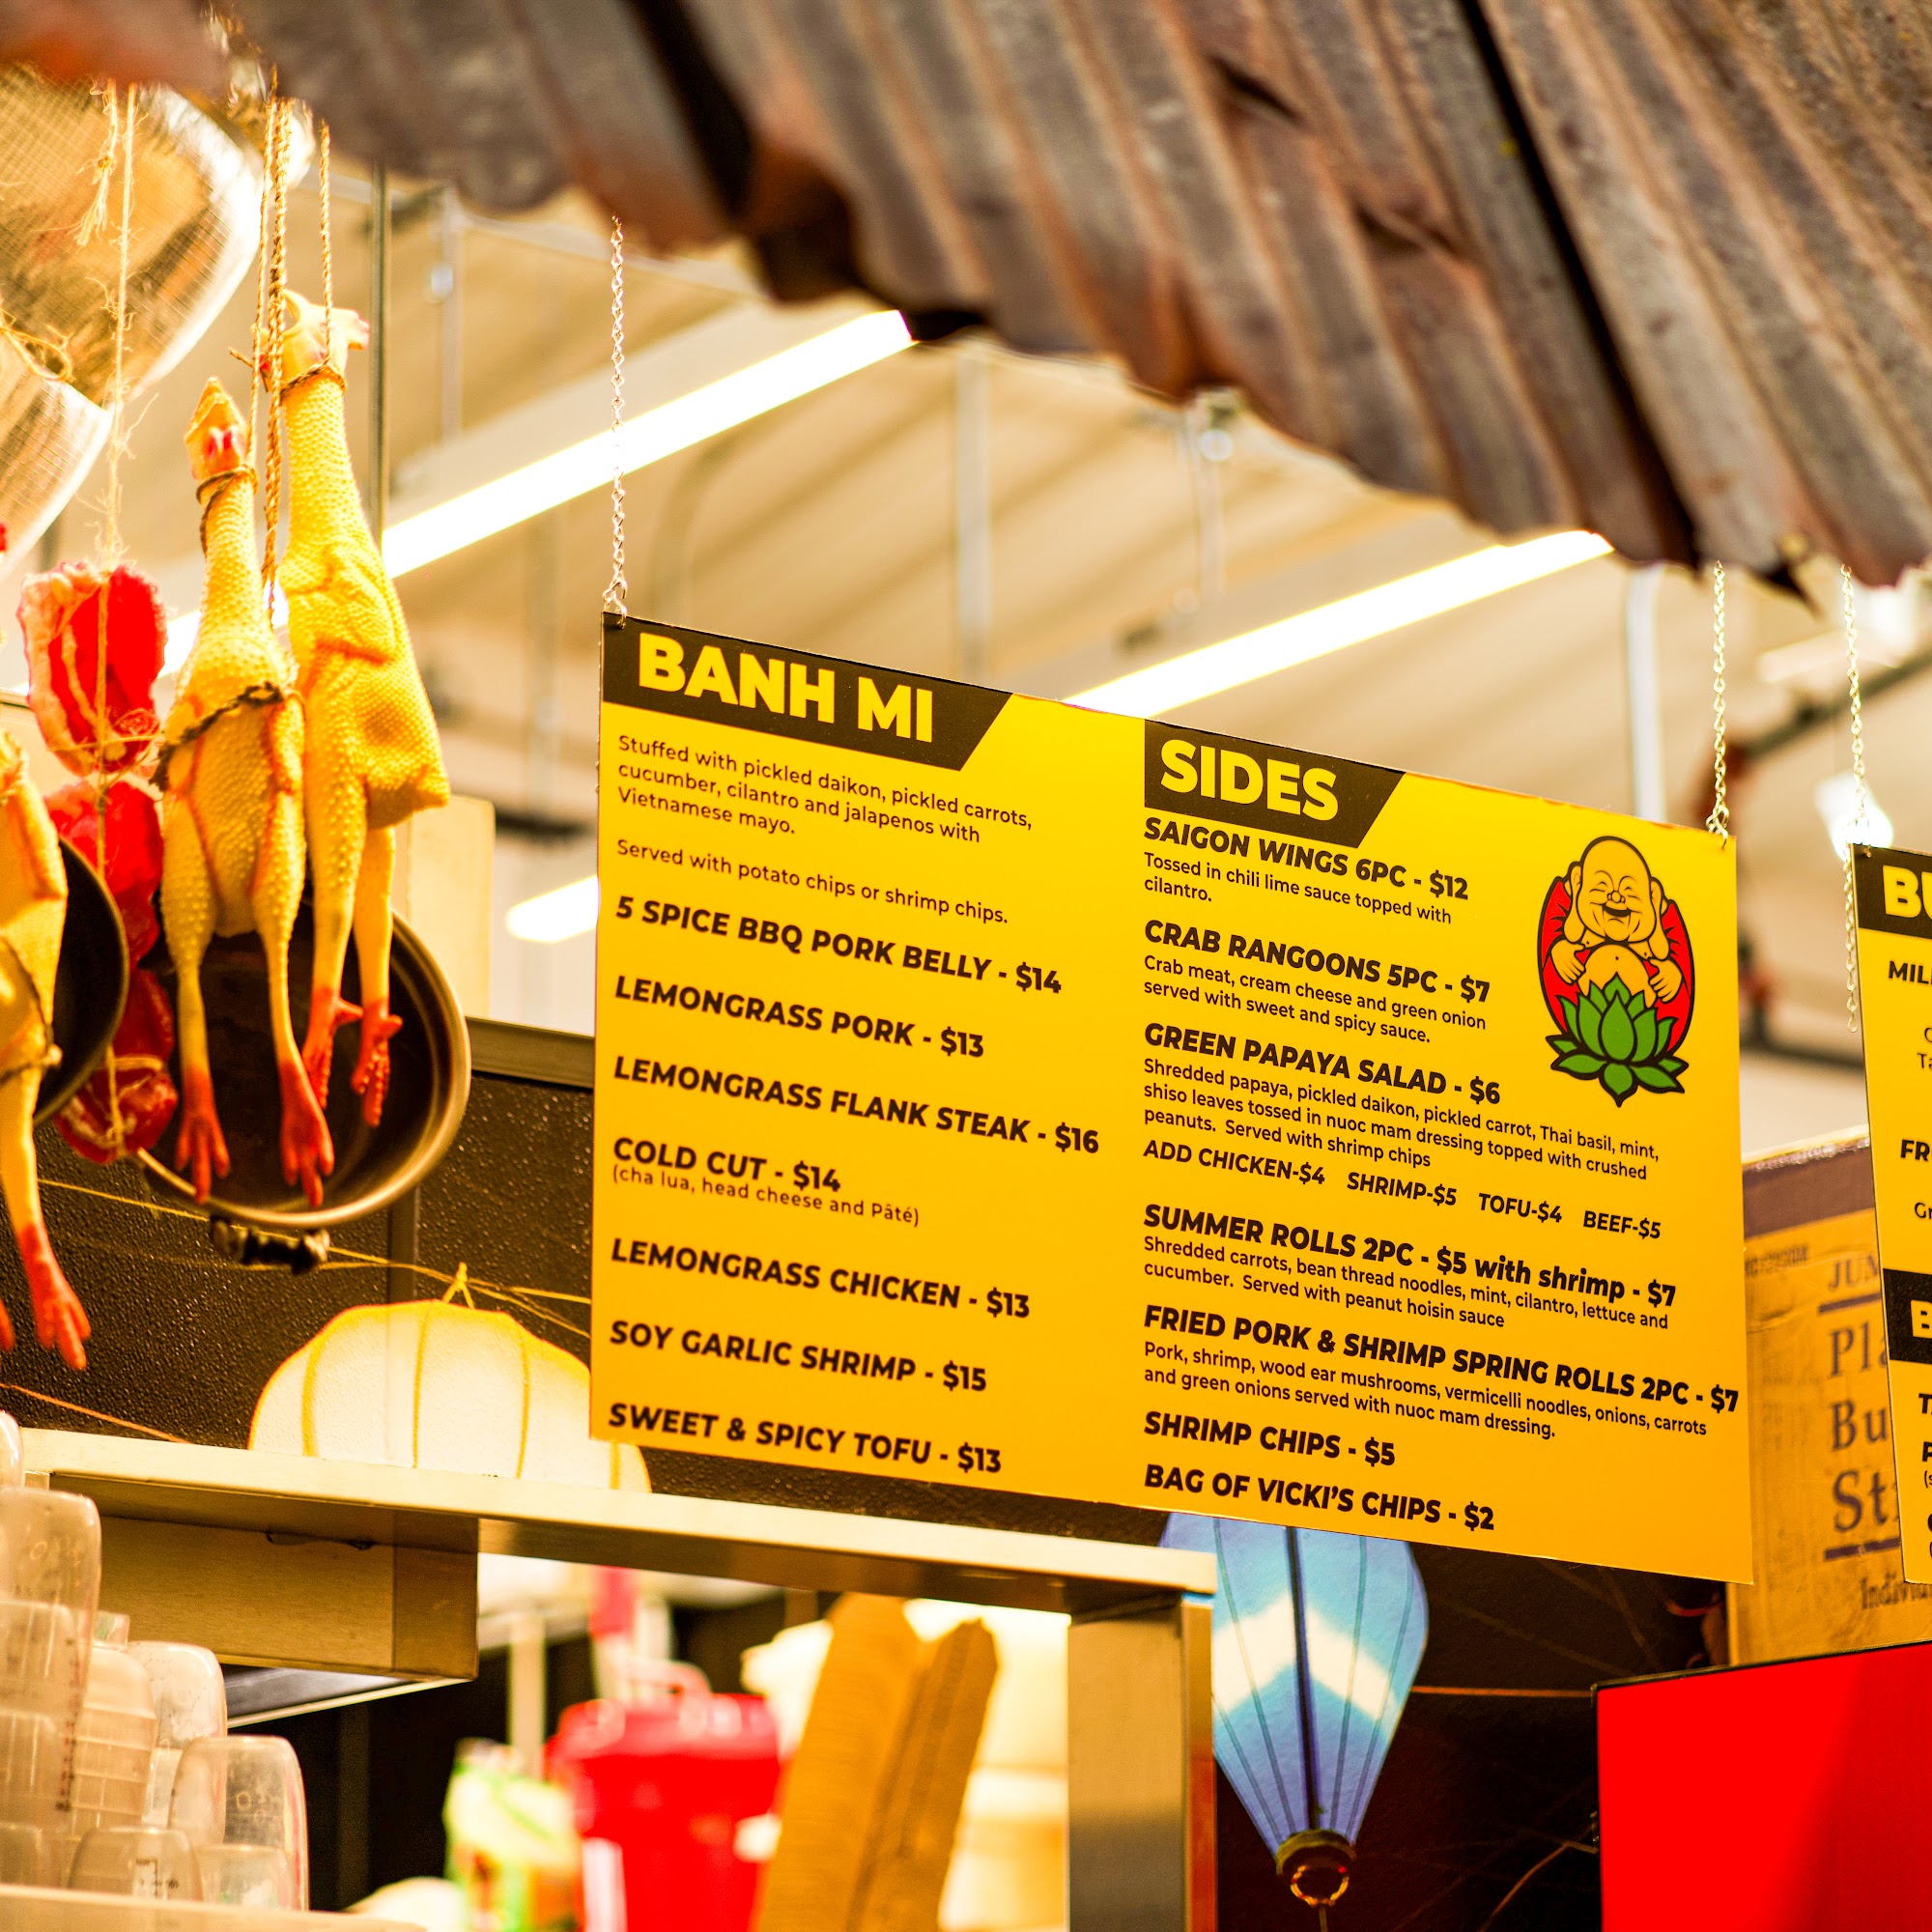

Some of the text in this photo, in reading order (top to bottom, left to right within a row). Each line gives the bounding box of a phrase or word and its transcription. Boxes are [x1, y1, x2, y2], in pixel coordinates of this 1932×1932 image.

[639, 632, 933, 743] BANH MI
[617, 786, 795, 835] Vietnamese mayo.
[618, 734, 1032, 831] Stuffed with pickled daikon, pickled carrots,
[618, 764, 980, 843] cucumber, cilantro and jalapenos with
[1160, 739, 1339, 821] SIDES
[617, 838, 1008, 924] Served with potato chips or shrimp chips.
[1143, 816, 1468, 900] SAIGON WINGS 6PC $12
[1144, 851, 1451, 924] Tossed in chili lime sauce topped with
[1144, 875, 1212, 902] cilantro.
[615, 895, 1062, 994] 5 SPICE BBQ PORK BELLY $14
[1145, 919, 1491, 1004] CRAB RANGOONS 5PC $7
[1888, 960, 1932, 985] MIL
[614, 975, 984, 1059] LEMONGRASS PORK $13
[1144, 954, 1486, 1031] Crab meat, cream cheese and green onion
[613, 1055, 1099, 1154] LEMONGRASS FLANK STEAK $16
[1144, 1022, 1501, 1105] GREEN PAPAYA SALAD $6
[1144, 1058, 1659, 1163] Shredded papaya, pickled daikon, pickled carrot, Thai basil, mint,
[1145, 1109, 1431, 1169] peanuts. Served with shrimp chips
[612, 1136, 841, 1193] COLD CUT $14
[612, 1163, 919, 1228] (cha lua, head cheese and Pâté)
[1142, 1139, 1662, 1240] ADD CHICKEN-$4 SHRIMP-$5 TOFU-$4 BEEF-$5
[611, 1237, 1030, 1319] LEMONGRASS CHICKEN $13
[1143, 1203, 1676, 1309] SUMMER ROLLS 2PC $5 with shrimp $7
[1144, 1263, 1505, 1328] cucumber. Served with peanut hoisin sauce
[610, 1320, 987, 1392] SOY GARLIC SHRIMP $15
[1144, 1304, 1226, 1338] FRIED
[1233, 1317, 1313, 1350] PORK
[1317, 1329, 1336, 1353] &
[1342, 1332, 1446, 1369] SHRIMP
[1452, 1349, 1549, 1384] SPRING
[1554, 1363, 1635, 1398] ROLLS
[1640, 1376, 1690, 1406] 2PC
[1710, 1383, 1739, 1414] $7
[1145, 1341, 1707, 1435] Pork, shrimp, wood ear mushrooms, vermicelli noodles, onions, carrots
[608, 1402, 1002, 1474] SWEET & SPICY TOFU $13
[1143, 1410, 1396, 1468] SHRIMP CHIPS $5
[1144, 1463, 1206, 1494] BAG
[1211, 1471, 1251, 1499] OF
[1361, 1491, 1441, 1523] CHIPS
[1463, 1500, 1494, 1532] $2
[1832, 1469, 1900, 1533] St
